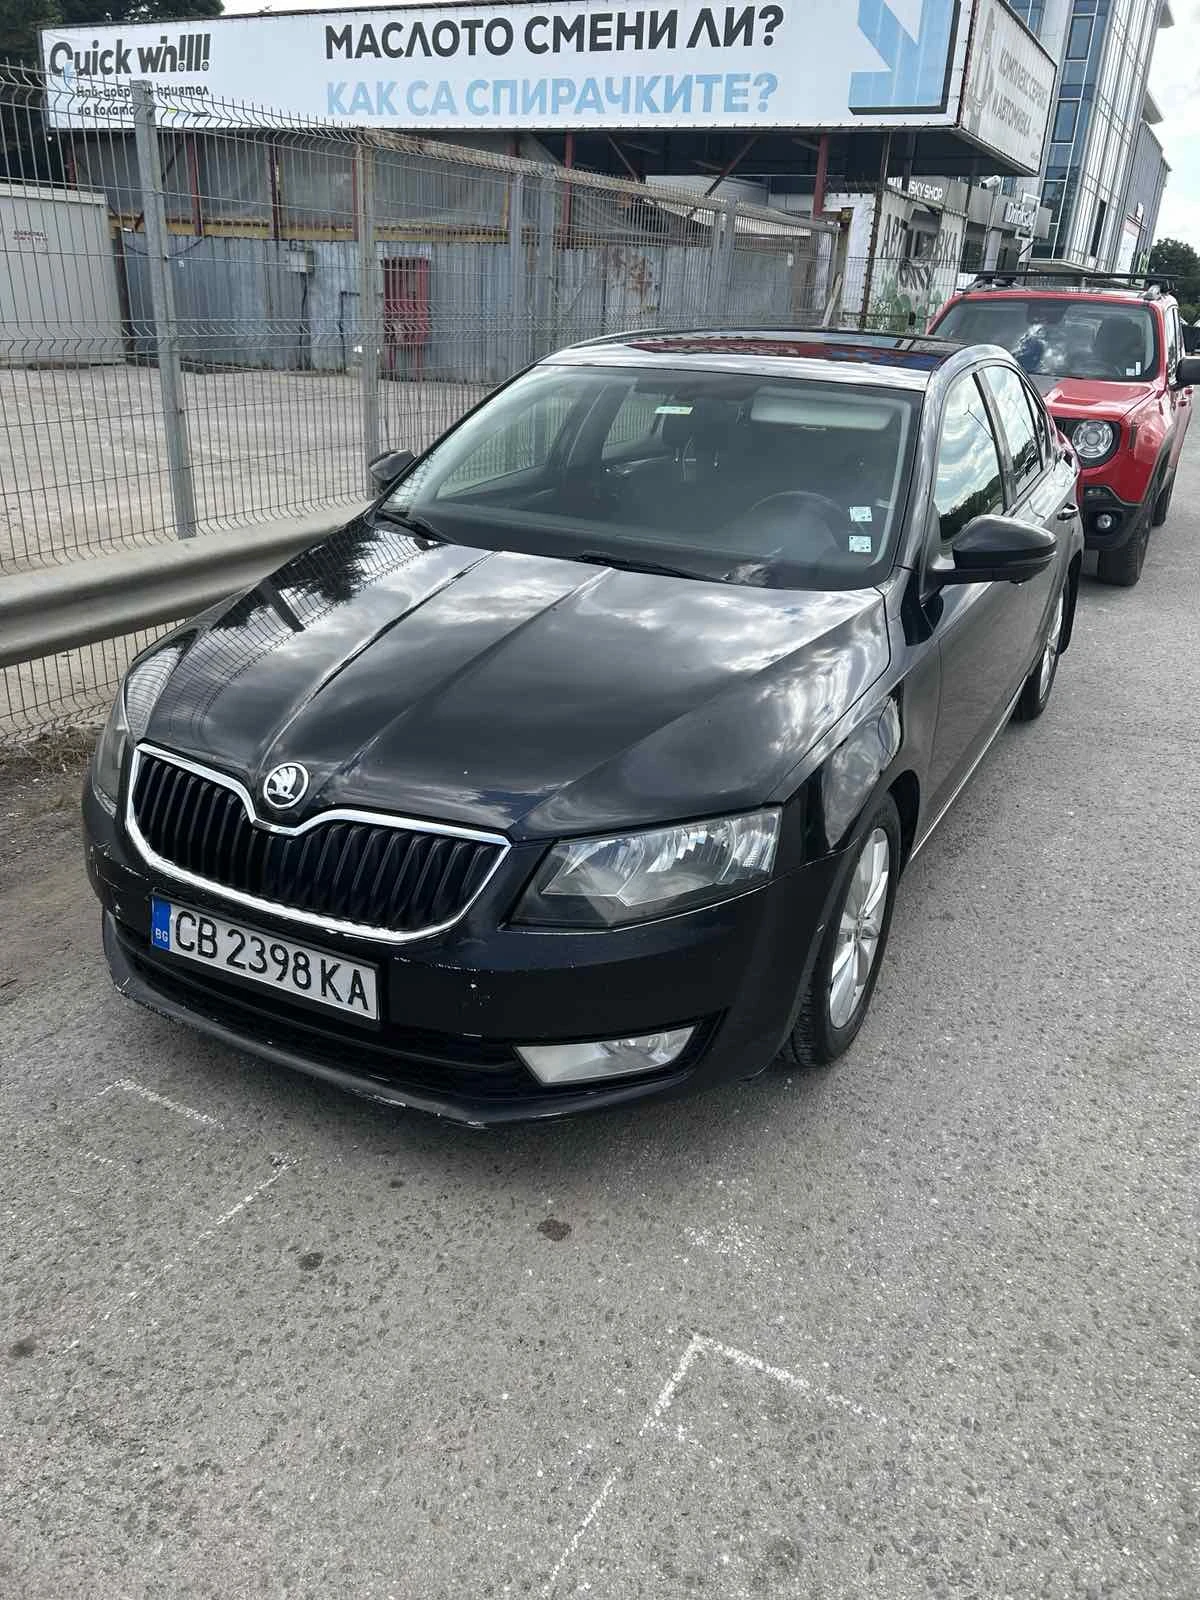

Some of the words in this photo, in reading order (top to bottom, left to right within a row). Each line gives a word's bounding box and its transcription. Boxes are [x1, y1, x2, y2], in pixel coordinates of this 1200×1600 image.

[325, 16, 514, 60] МАСЛОТО
[524, 9, 678, 55] СМЕНИ
[687, 5, 784, 49] ЛИ?
[50, 40, 132, 79] Quick
[327, 81, 398, 117] КАК
[406, 80, 457, 116] СА
[466, 72, 779, 116] СПИРАЧКИТЕ?
[155, 928, 168, 943] BG
[174, 910, 217, 959] CB
[226, 928, 312, 990] 2398
[320, 958, 369, 1011] KA
